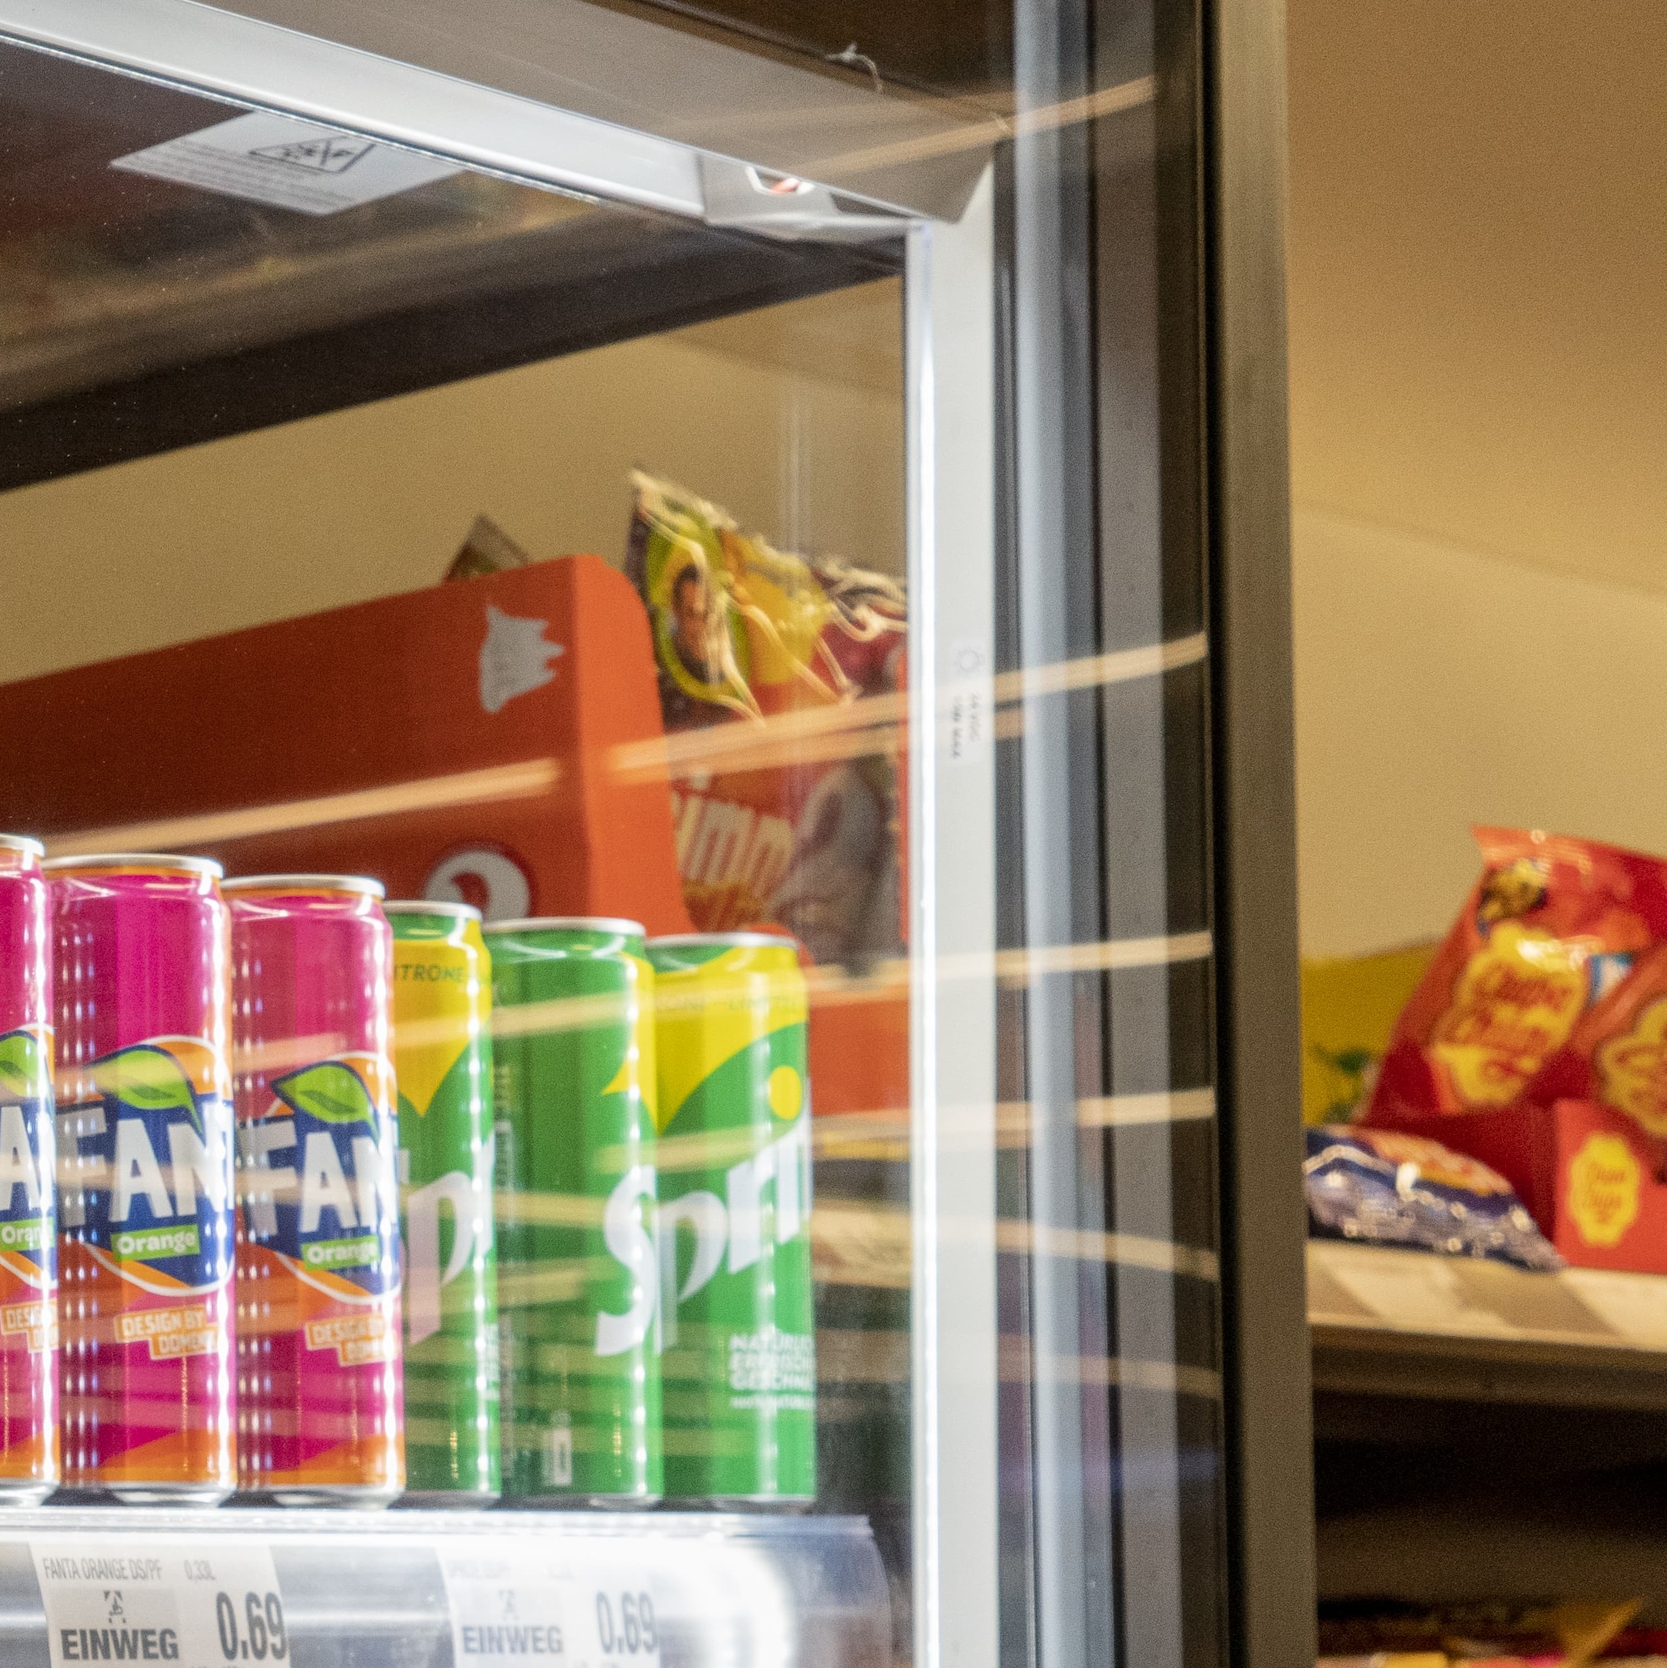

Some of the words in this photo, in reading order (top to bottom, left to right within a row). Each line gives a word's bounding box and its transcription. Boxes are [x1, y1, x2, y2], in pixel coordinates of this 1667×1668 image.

[57, 1096, 233, 1226] FAN
[238, 1122, 397, 1235] FAN
[117, 1227, 196, 1255] Orange
[42, 1557, 81, 1580] FANTA
[81, 1558, 129, 1581] ORANGE
[131, 1558, 162, 1581] DS/PF
[60, 1629, 180, 1660] EINWEG
[216, 1591, 288, 1661] 0.69
[462, 1625, 563, 1653] EINWEG
[596, 1591, 658, 1654] 0.69
